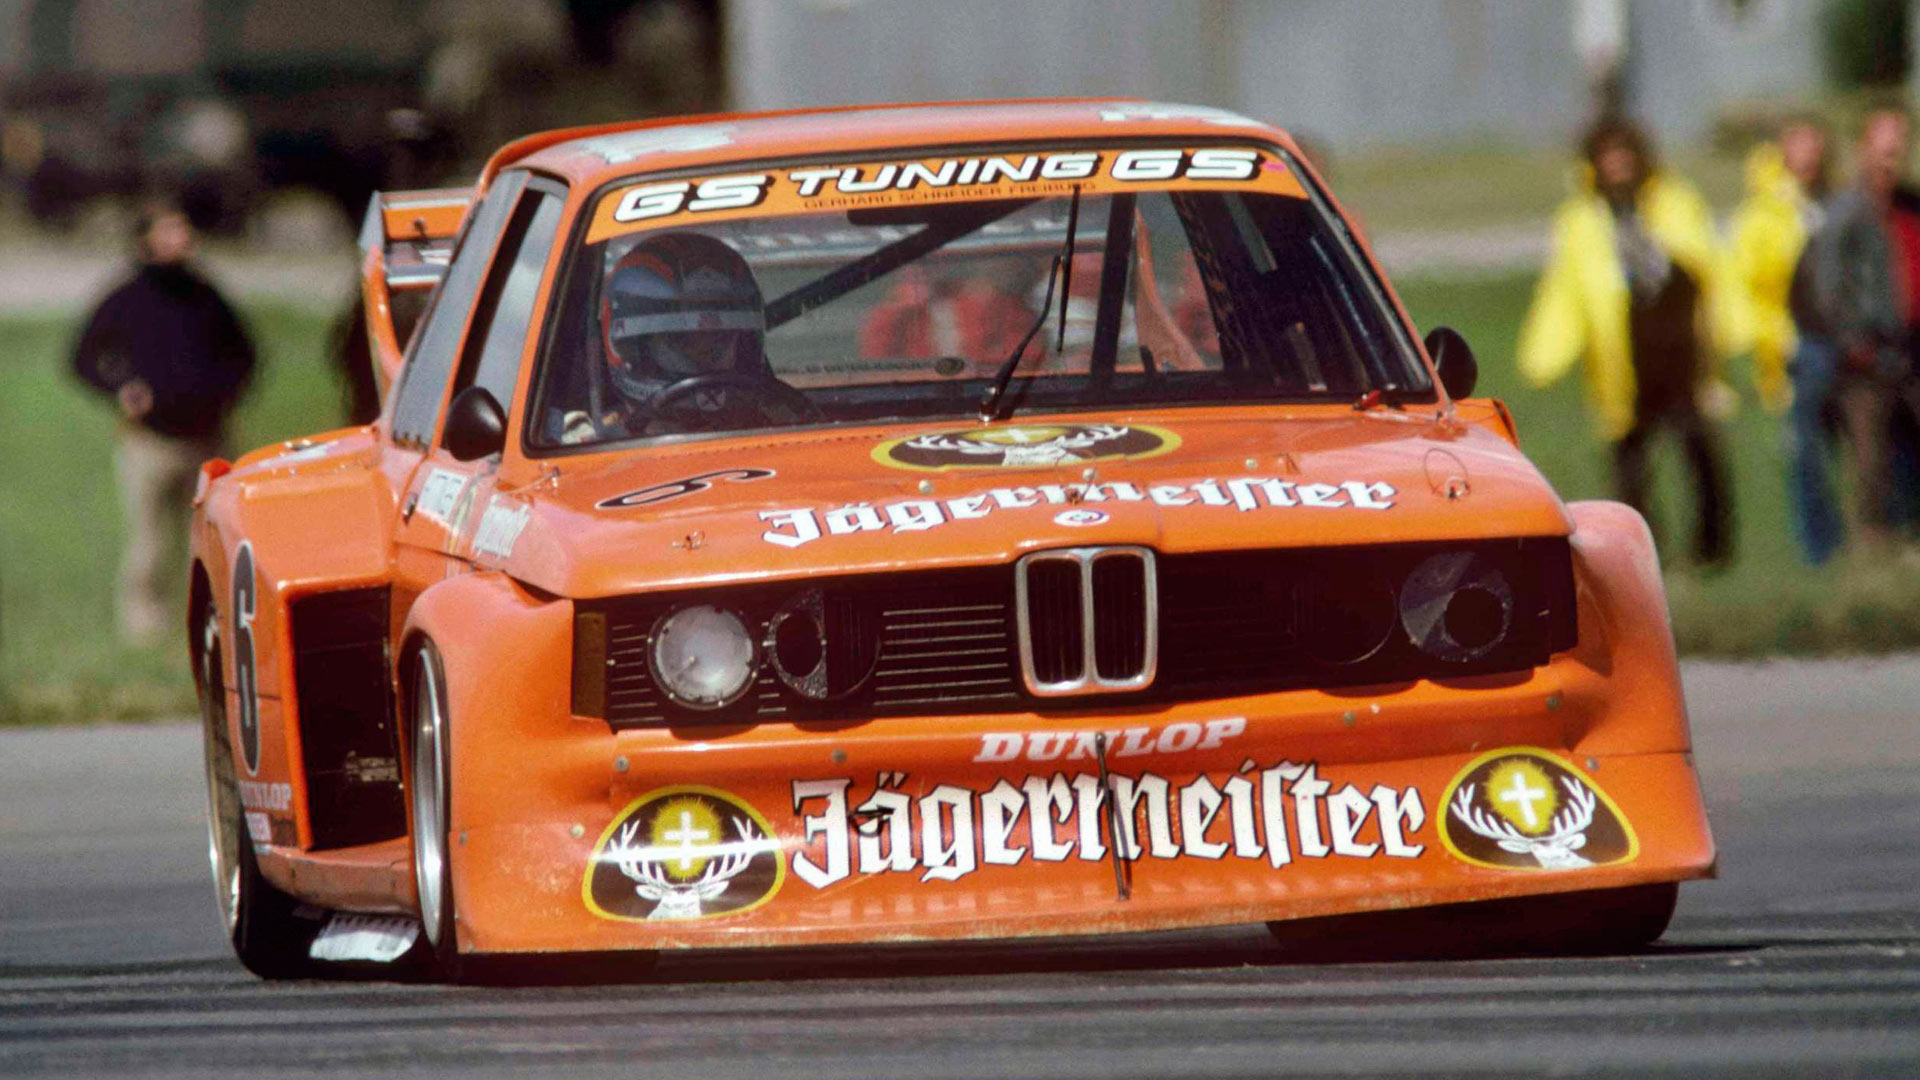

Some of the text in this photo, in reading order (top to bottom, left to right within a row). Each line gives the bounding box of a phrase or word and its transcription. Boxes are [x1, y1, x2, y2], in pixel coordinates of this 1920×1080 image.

[614, 149, 1263, 223] GS TUNING GS
[803, 194, 893, 209] GERHARD
[900, 186, 1000, 202] SCHNEIDER
[594, 466, 777, 510] 6
[234, 541, 259, 777] 6
[974, 718, 1246, 763] DUNLOP
